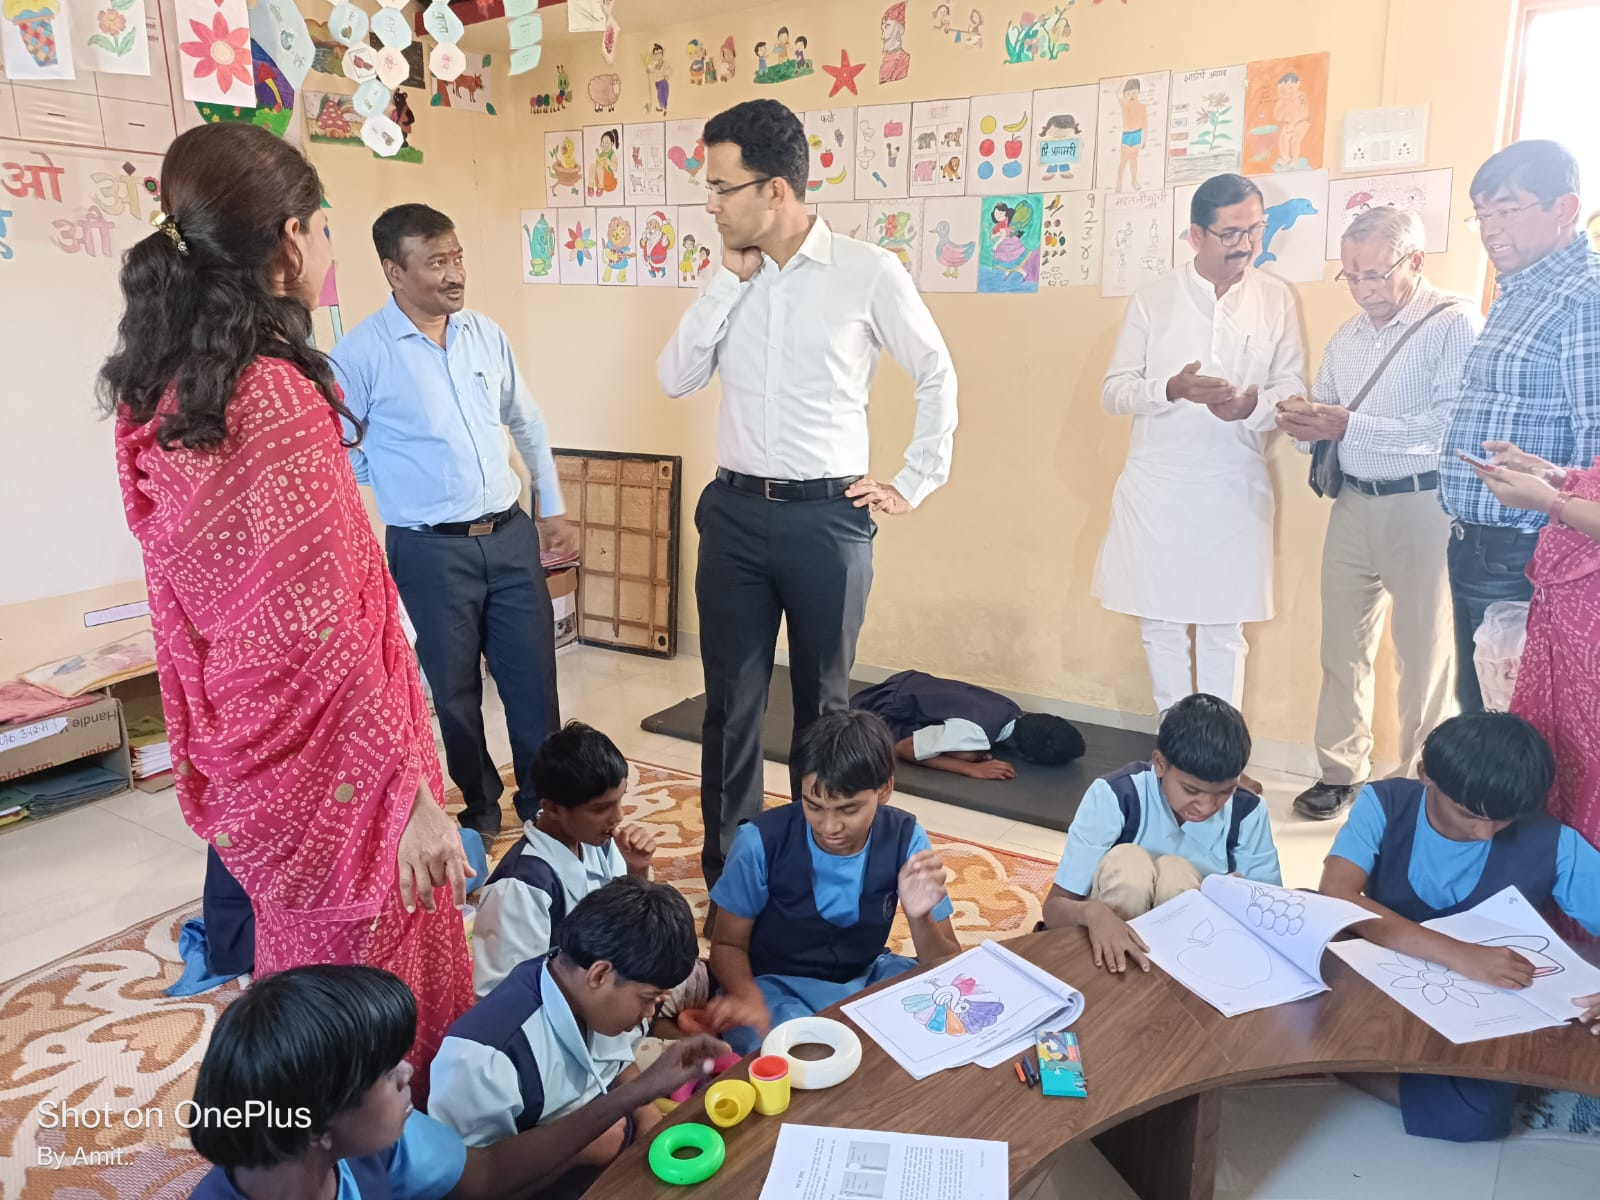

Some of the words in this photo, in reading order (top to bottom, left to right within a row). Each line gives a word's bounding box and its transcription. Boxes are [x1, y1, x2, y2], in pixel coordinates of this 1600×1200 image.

[1, 151, 65, 203] ओ
[51, 205, 115, 257] औ
[72, 709, 117, 728] Handle
